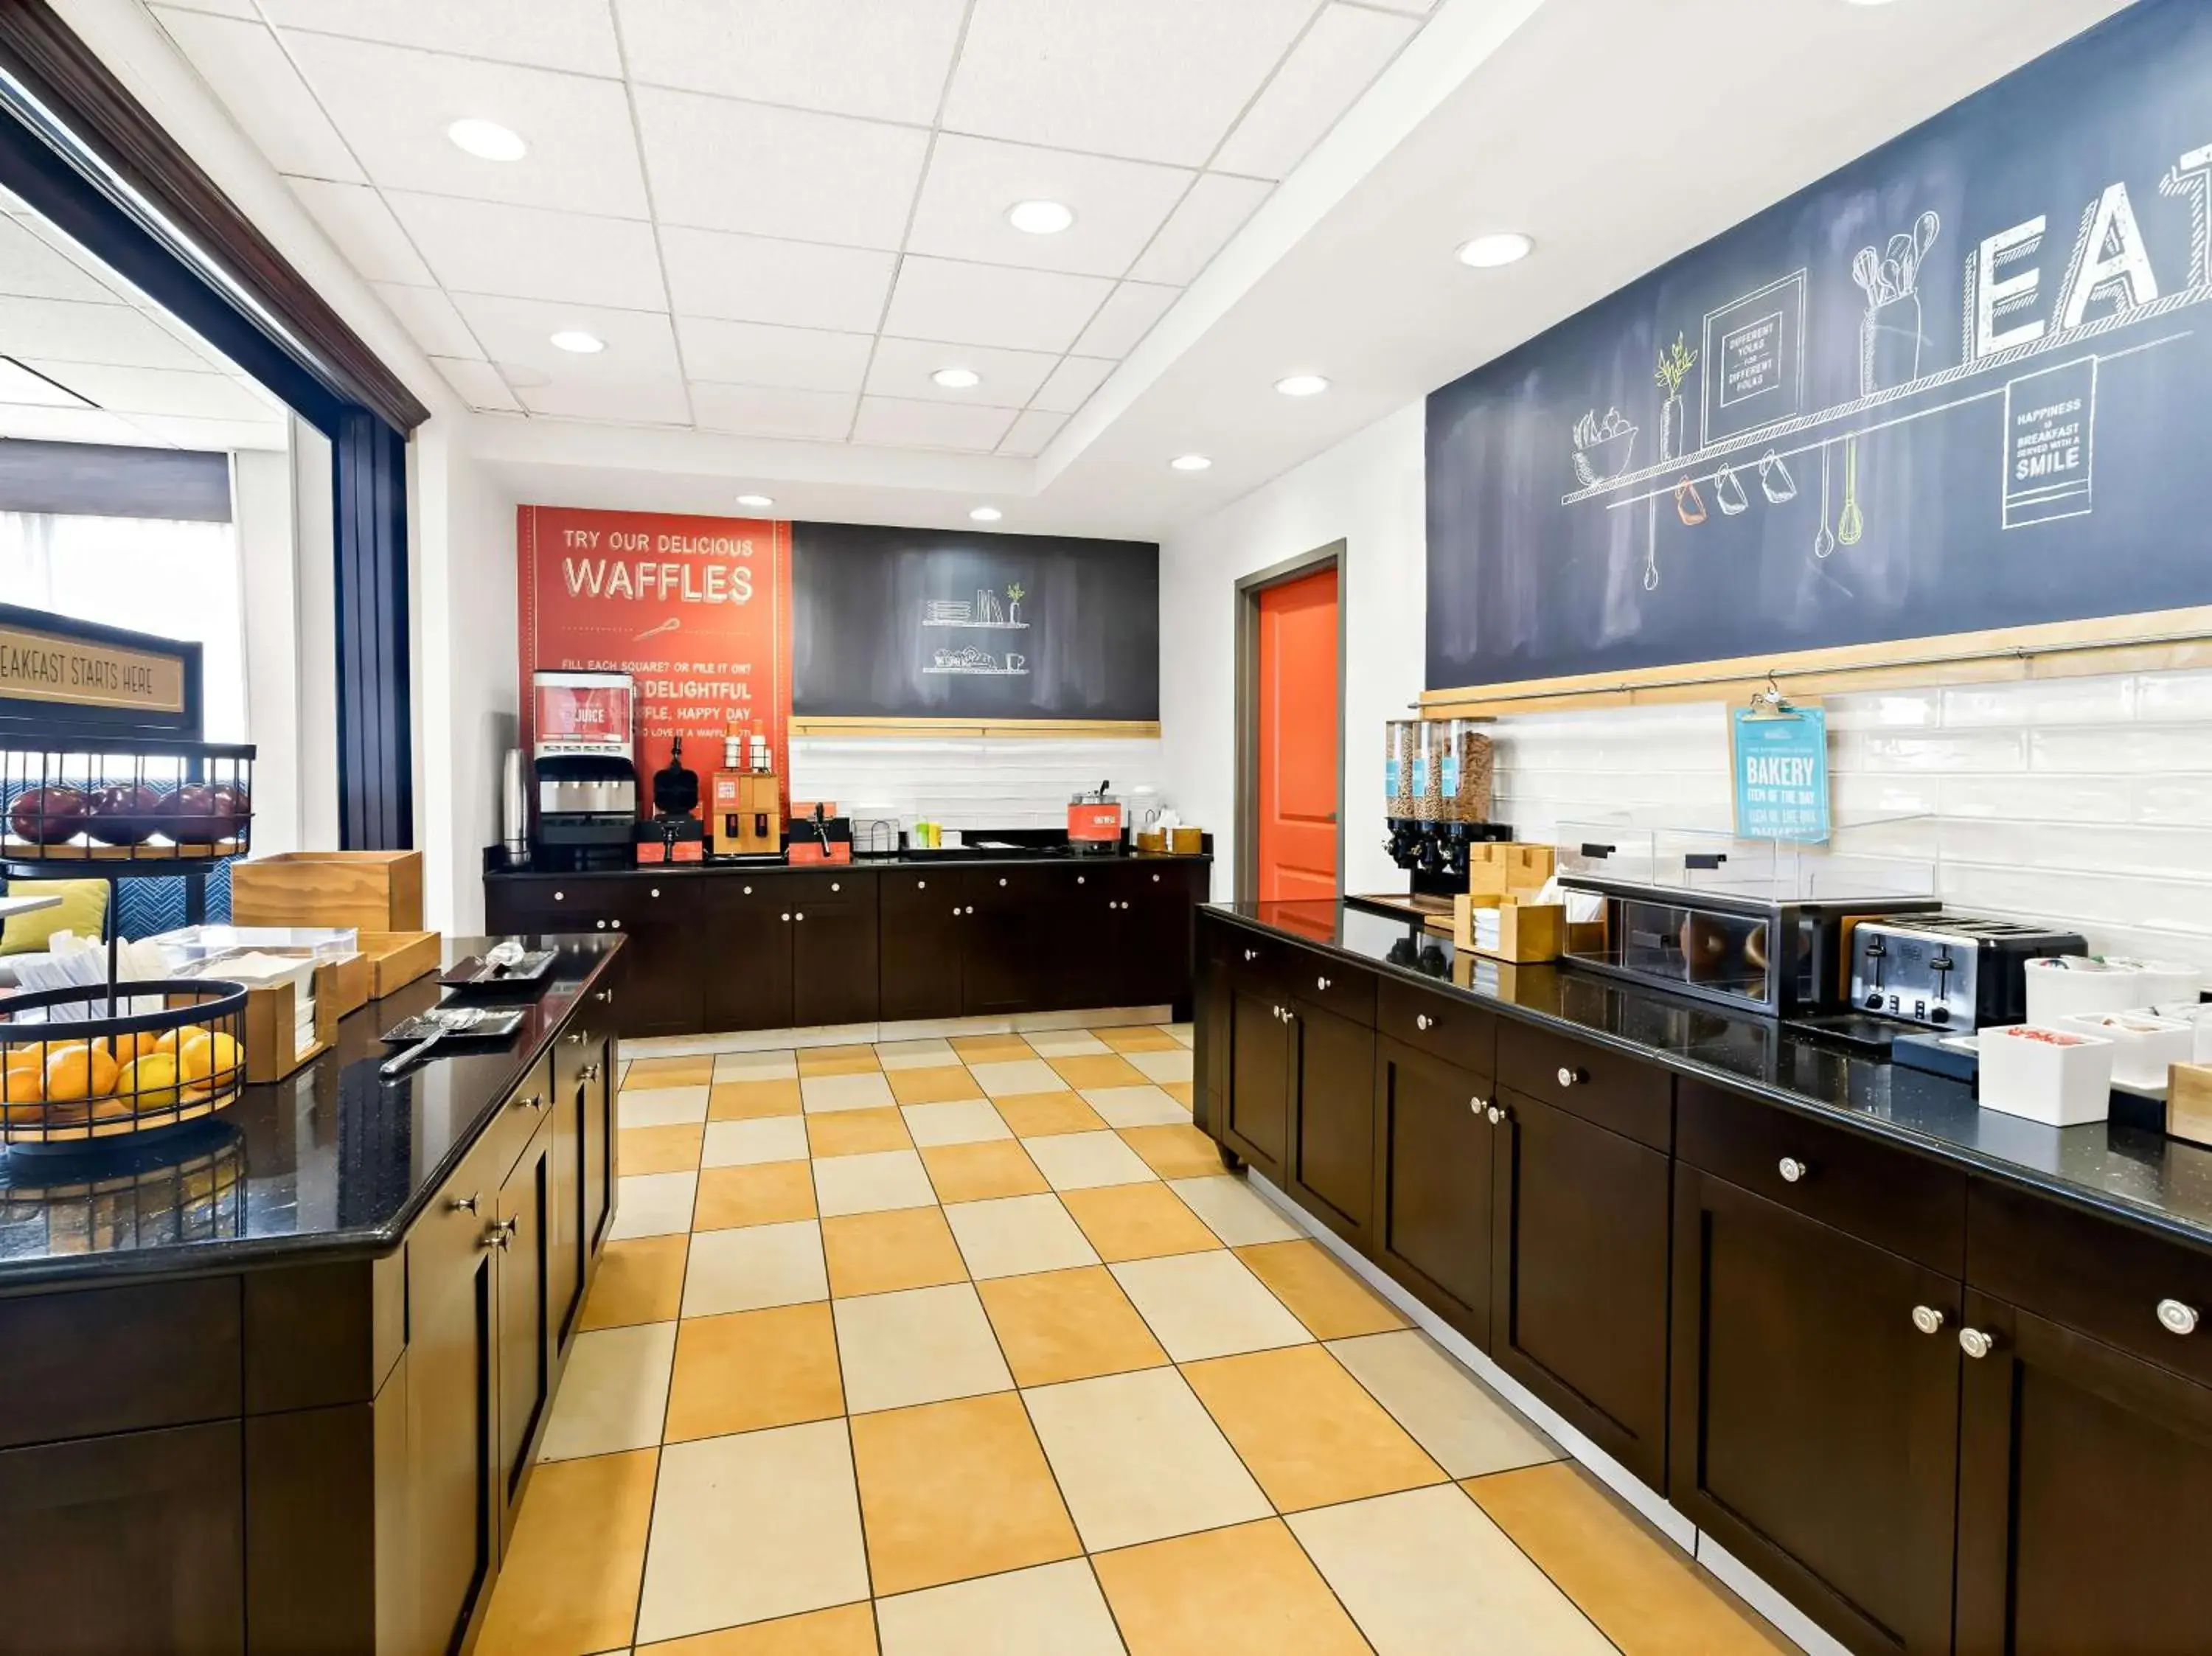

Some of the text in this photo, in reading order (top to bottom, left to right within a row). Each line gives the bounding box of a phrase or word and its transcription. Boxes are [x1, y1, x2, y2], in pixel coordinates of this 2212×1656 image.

[1729, 322, 1773, 349] DIFFERENT
[1729, 358, 1771, 384] DIFFERENT
[2017, 398, 2081, 425] HAPPINESS
[2017, 422, 2079, 448] BREAKFAST
[2017, 436, 2079, 457] SERVED WITH A
[2014, 445, 2080, 481] SMILE
[563, 530, 753, 556] TRY OUR DELICIOUS
[562, 557, 754, 605] WAFFLES
[0, 644, 153, 695] EAKFAST STARTS HERE
[562, 659, 751, 674] FILL EACH SQUARE? OR PILE IT ON?
[645, 679, 751, 700] DELIGHTFUL
[574, 709, 604, 723] JUICE
[677, 707, 720, 720] HAPPY
[726, 708, 750, 721] DAY
[651, 728, 672, 736] LOVE
[697, 728, 727, 737] WAFFL
[1747, 756, 1814, 787] BAKERY
